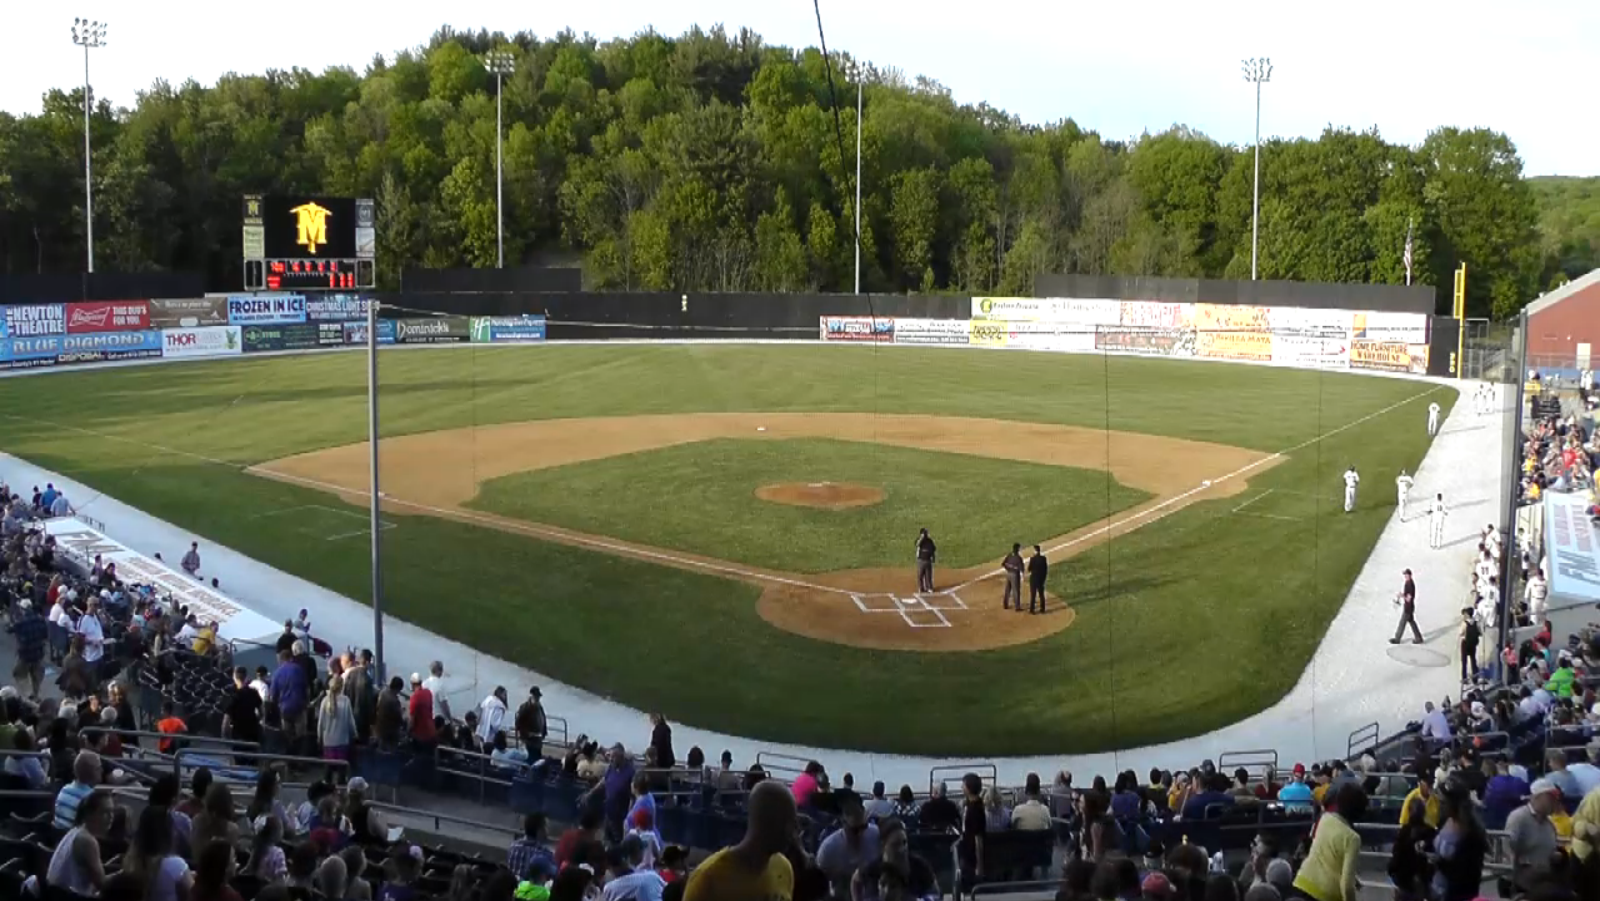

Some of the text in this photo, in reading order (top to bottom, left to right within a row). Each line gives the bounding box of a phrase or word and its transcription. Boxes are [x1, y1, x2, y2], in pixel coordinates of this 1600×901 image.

[13, 305, 63, 321] NEWTON
[229, 299, 304, 314] FROZEN IN ICE
[14, 319, 64, 336] THEATRE
[113, 315, 126, 326] FOR
[13, 333, 145, 353] BLUE DIAMOND
[165, 333, 197, 347] THOR
